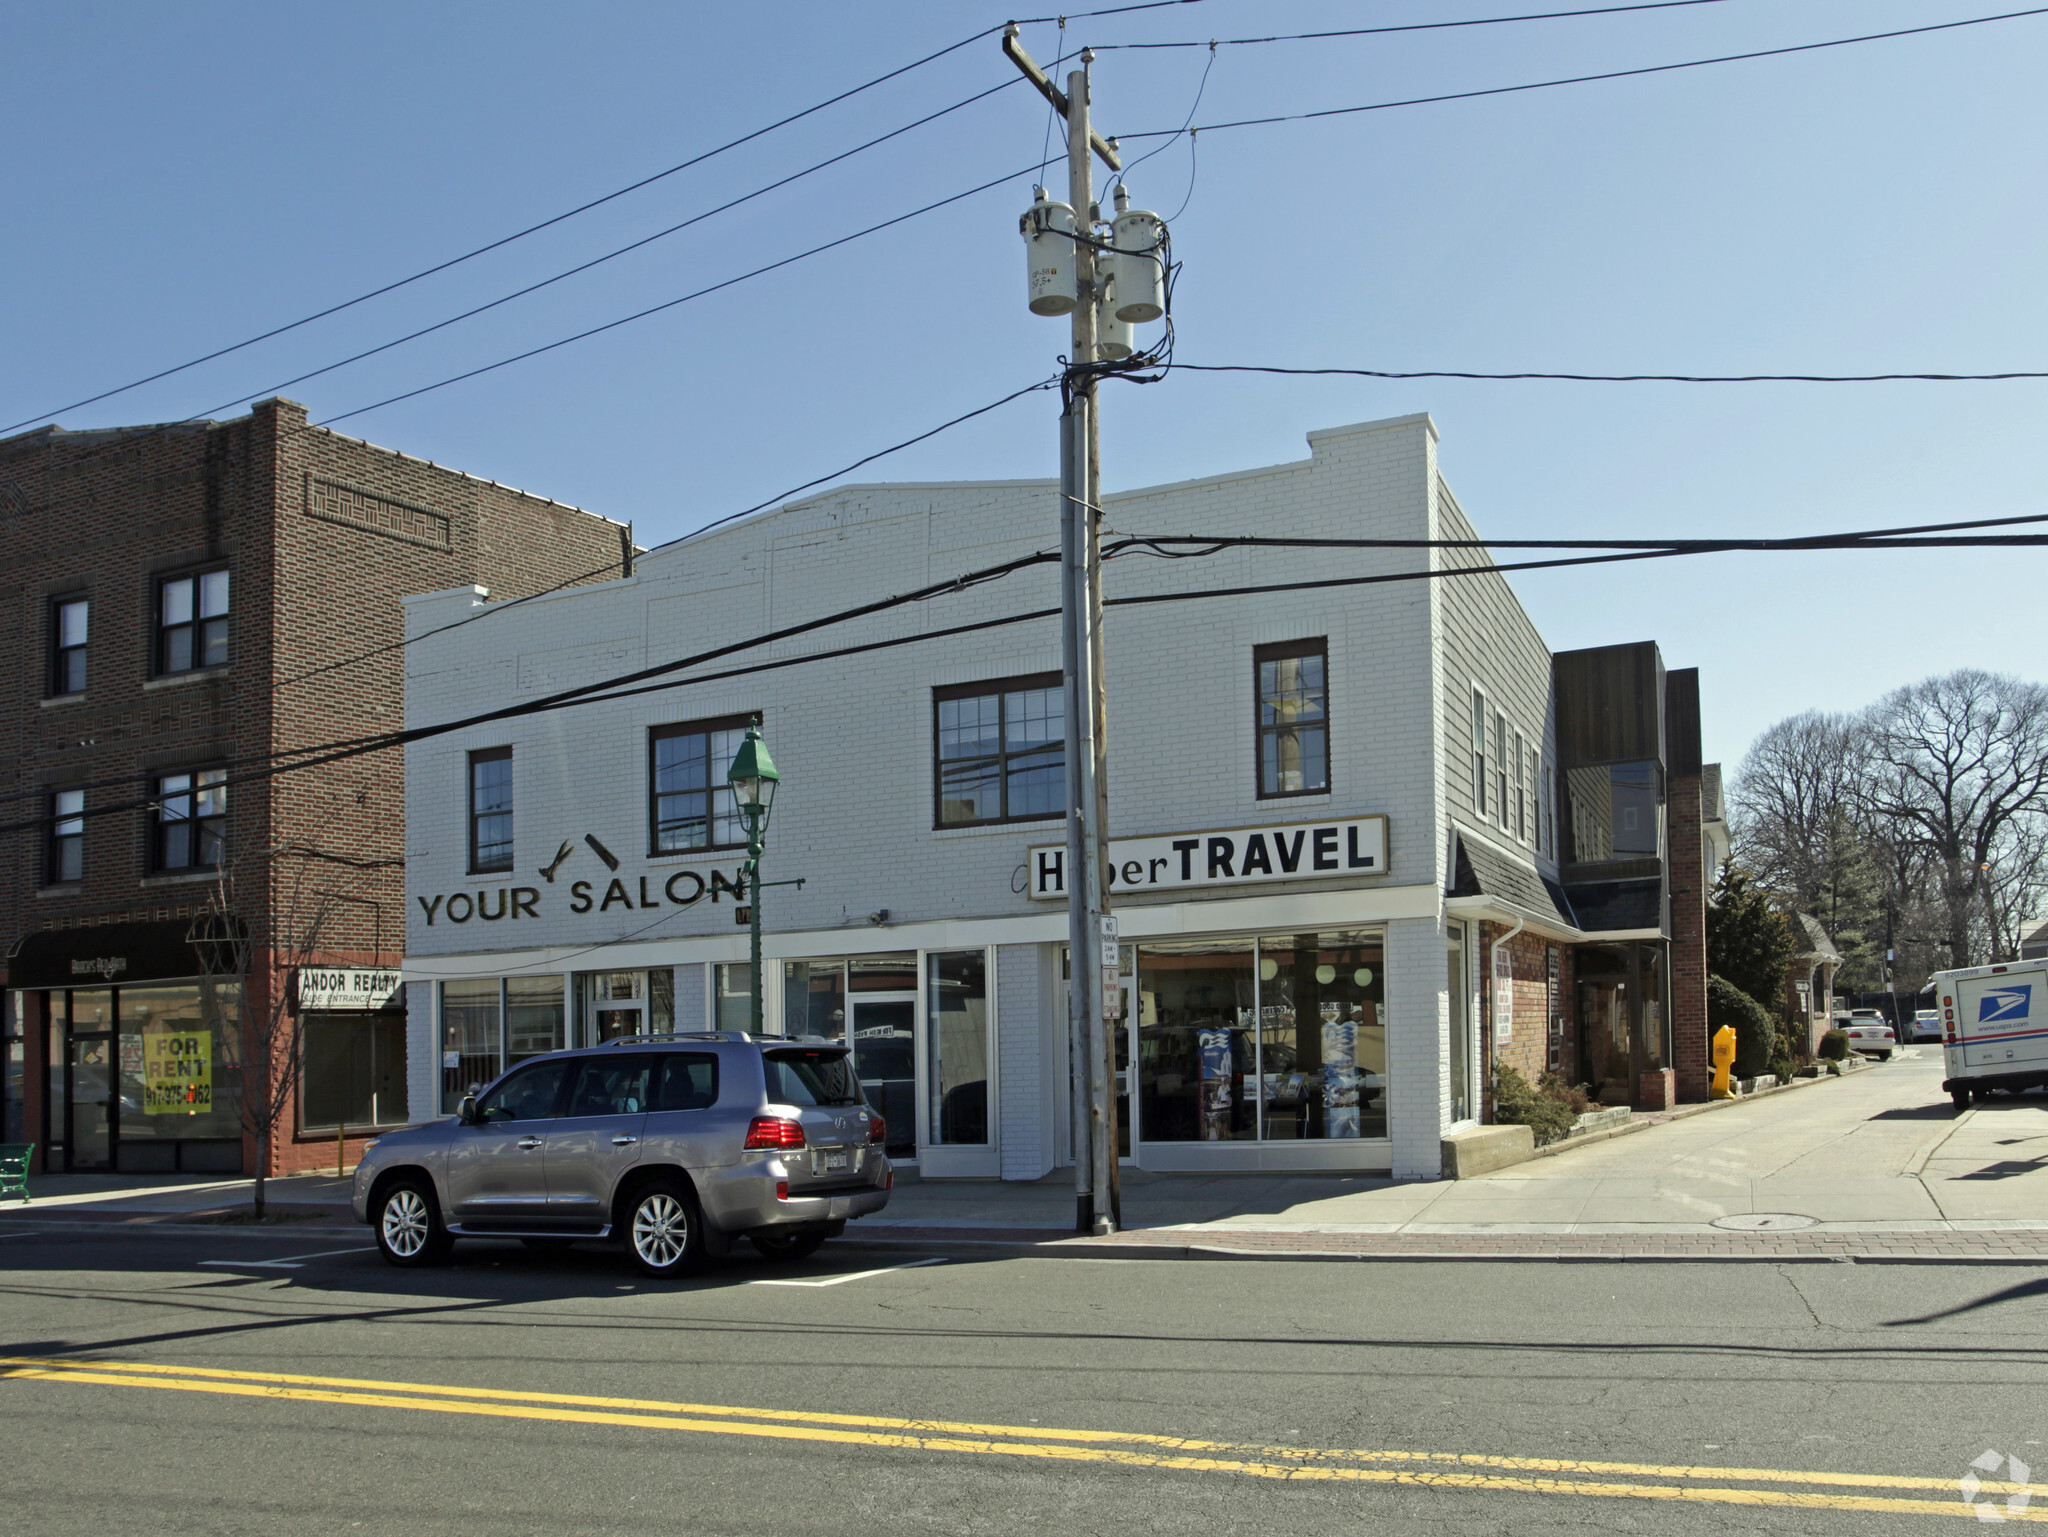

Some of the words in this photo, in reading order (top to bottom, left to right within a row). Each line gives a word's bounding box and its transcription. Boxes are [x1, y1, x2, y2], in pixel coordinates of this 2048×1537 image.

[1172, 825, 1374, 881] TRAVEL
[417, 887, 541, 926] YOUR
[570, 867, 745, 914] SALON
[1105, 922, 1113, 932] NO
[303, 973, 346, 992] ANDOR
[353, 974, 398, 992] REALTY
[1944, 968, 1979, 979] 8203899
[303, 994, 323, 1003] SIDE
[327, 994, 371, 1003] ENTRANCE
[1978, 1021, 2029, 1032] www.usps.com
[156, 1038, 199, 1056] FOR
[148, 1059, 206, 1078] RENT
